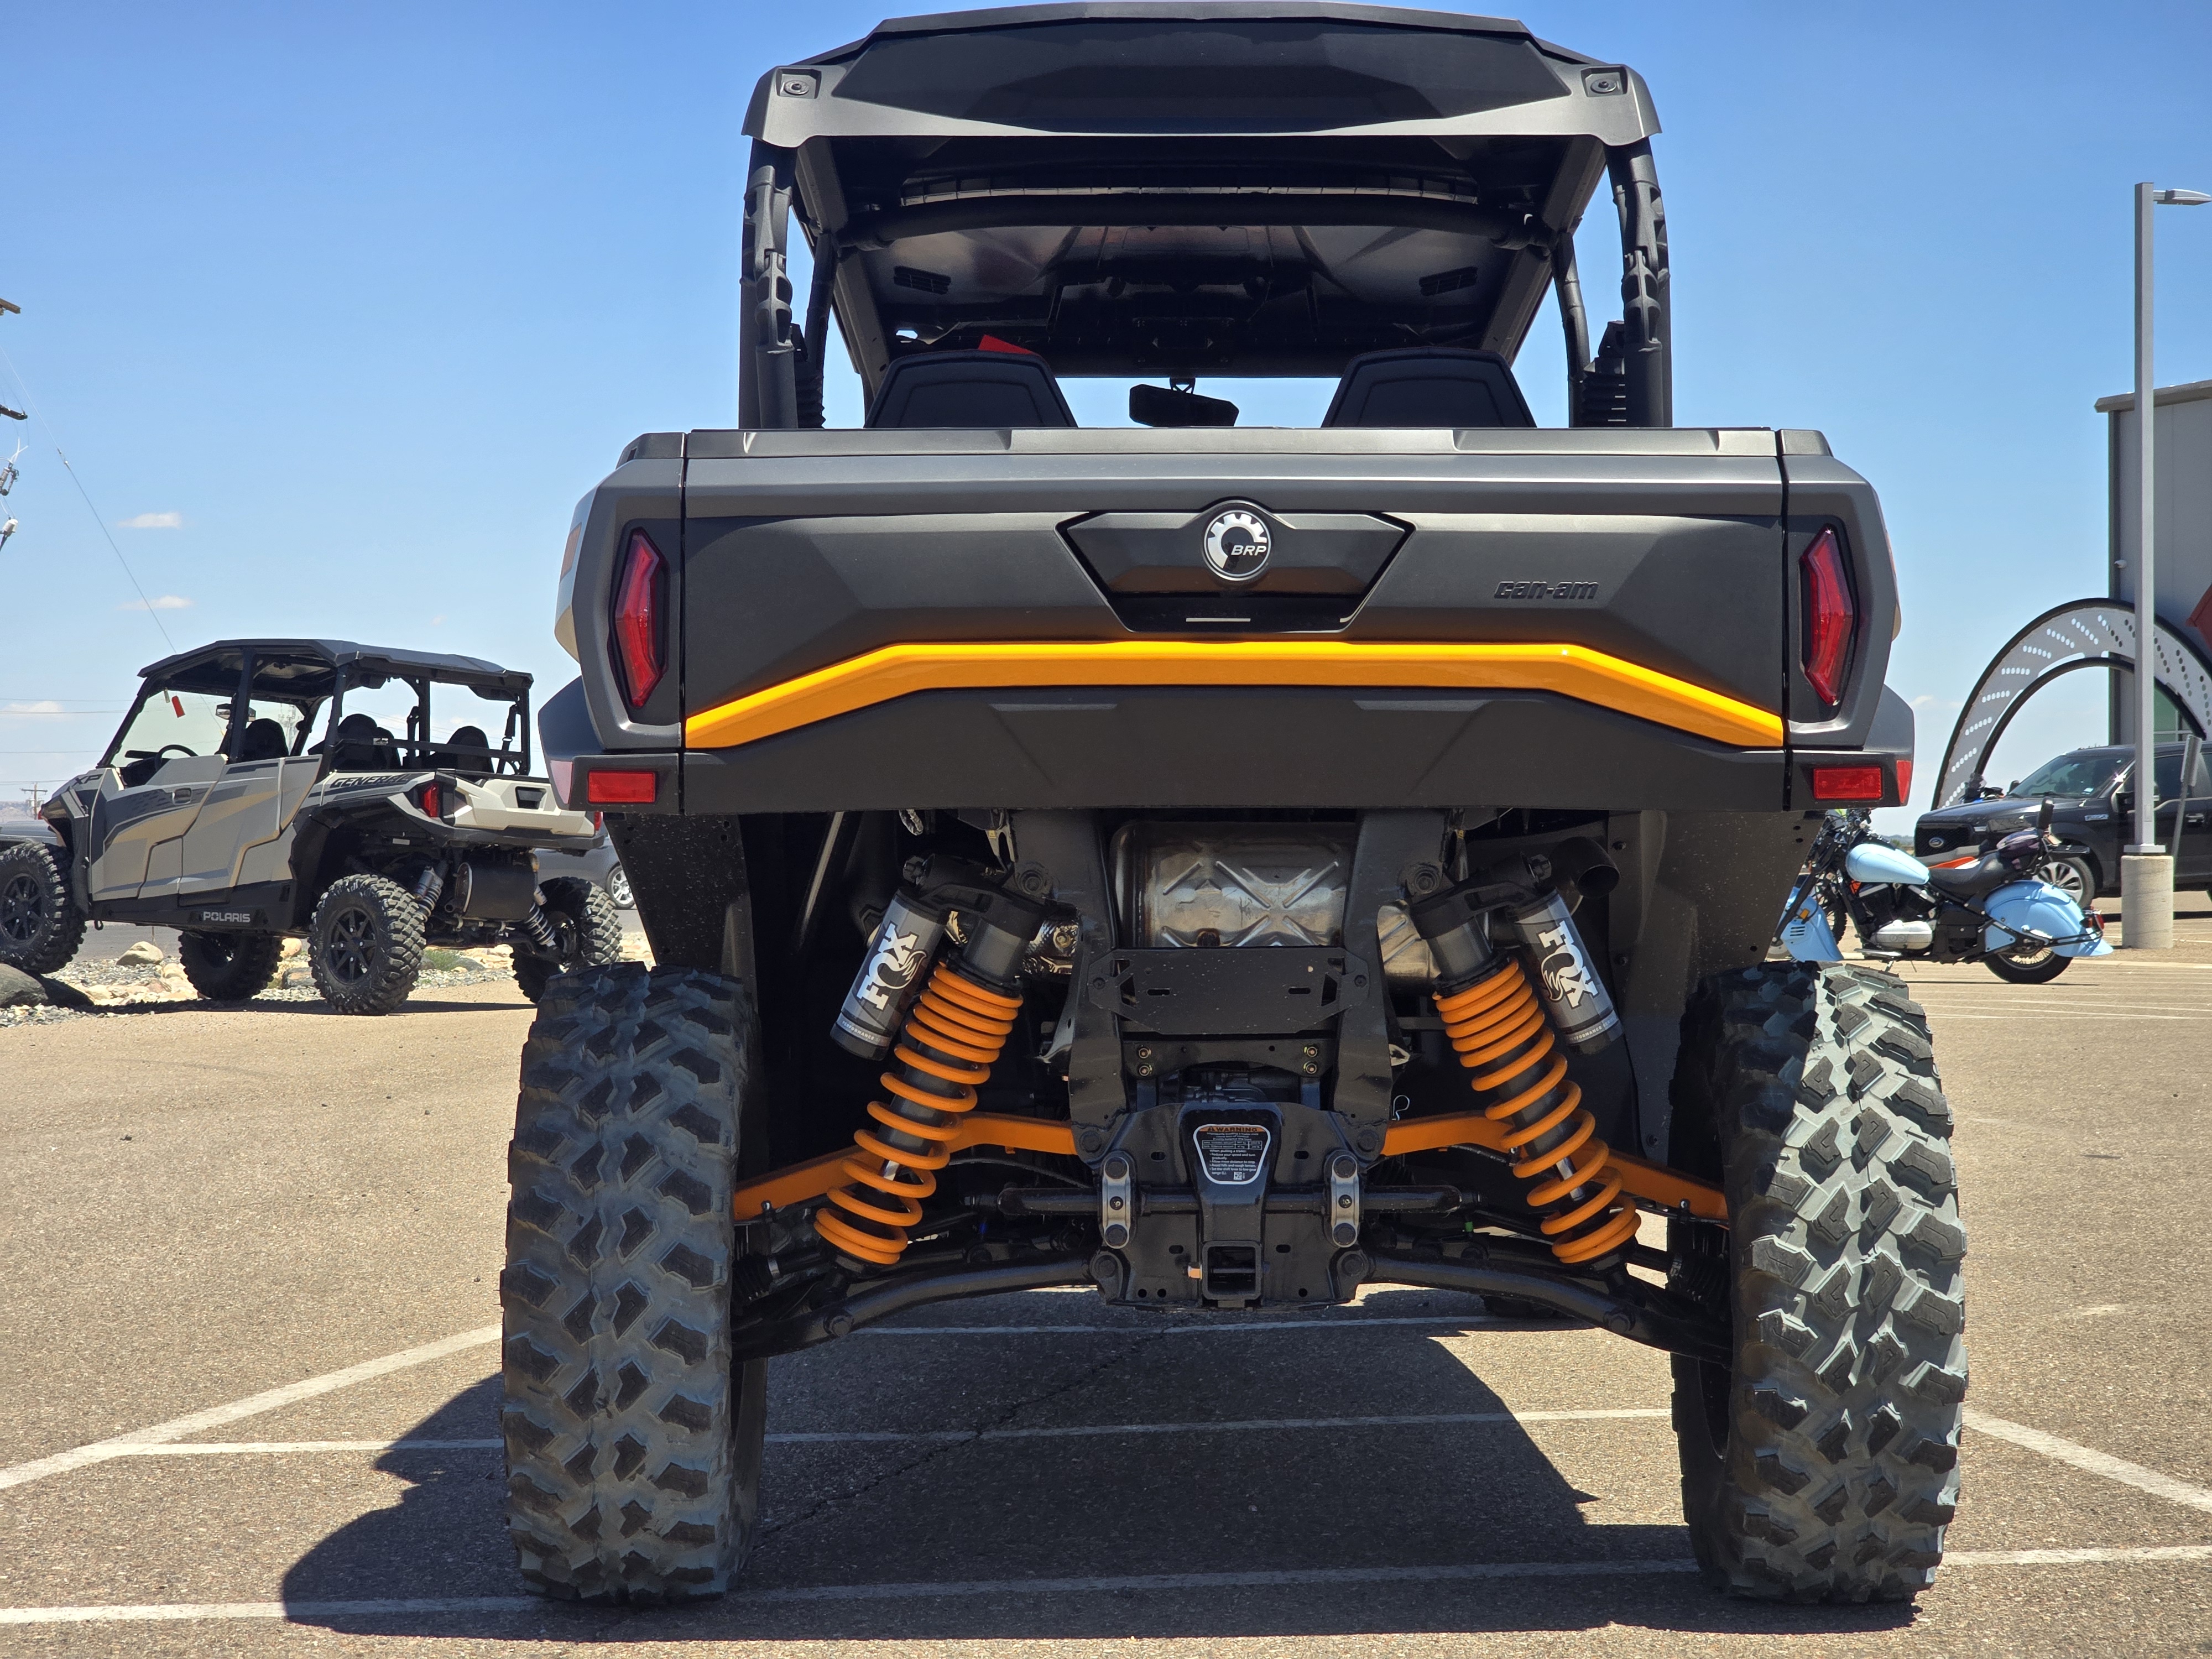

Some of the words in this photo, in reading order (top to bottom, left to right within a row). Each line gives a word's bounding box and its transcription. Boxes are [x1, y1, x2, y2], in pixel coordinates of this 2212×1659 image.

[1231, 545, 1266, 556] BRP
[1494, 581, 1599, 599] can-am
[71, 774, 103, 787] XP
[330, 774, 411, 788] GENERAL
[203, 911, 251, 923] POLARIS
[857, 922, 926, 1010] FOX
[1538, 920, 1598, 1008] FOX
[842, 1020, 875, 1040] PERFORMANCE
